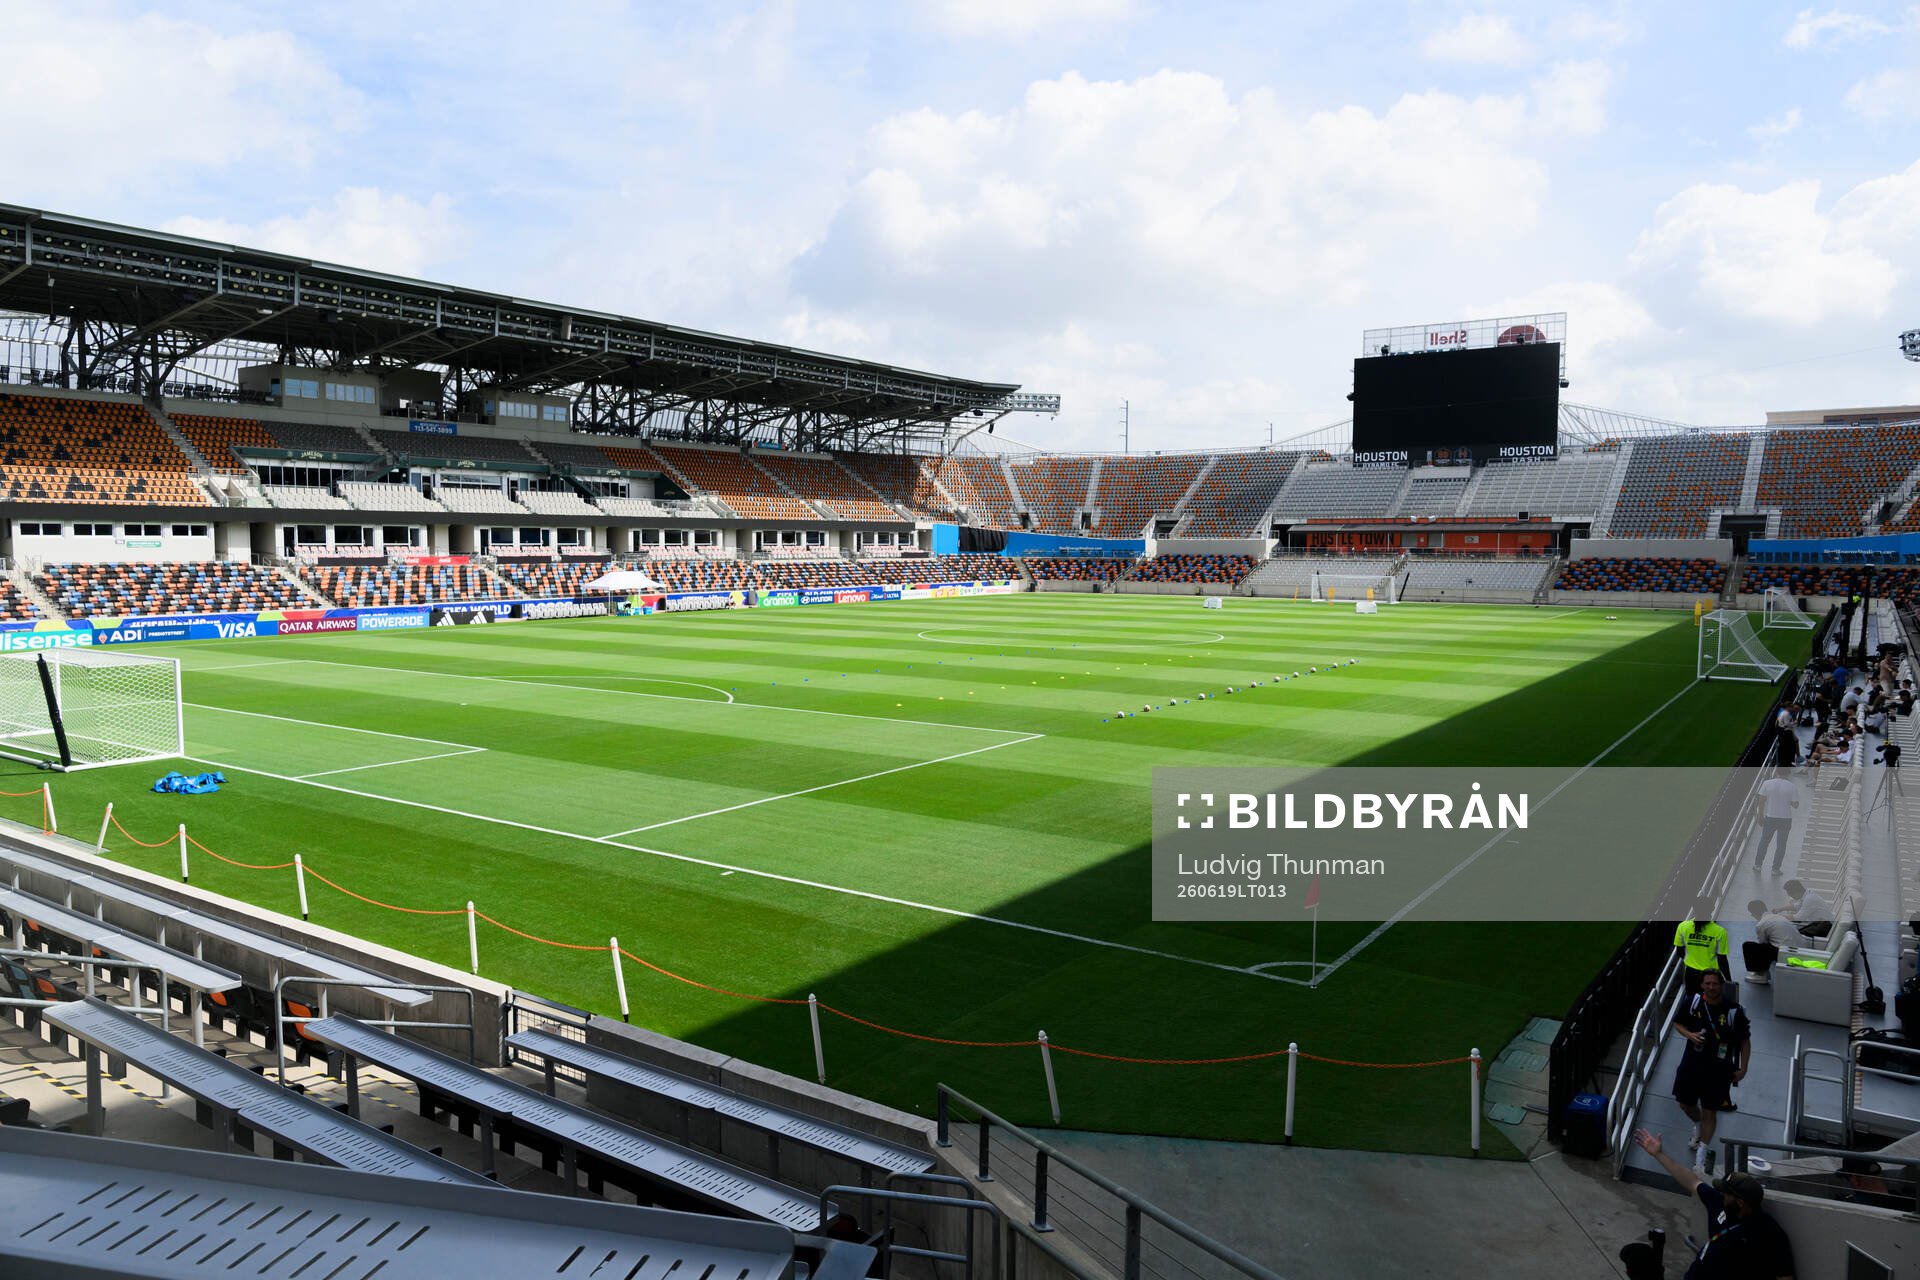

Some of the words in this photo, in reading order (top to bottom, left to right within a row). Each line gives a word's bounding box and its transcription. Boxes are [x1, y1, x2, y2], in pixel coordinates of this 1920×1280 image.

[1355, 450, 1408, 462] HOUSTON
[1499, 445, 1554, 457] HOUSTON
[1359, 532, 1394, 545] TOWN
[763, 597, 795, 606] aramco
[838, 592, 866, 603] Lenovo
[279, 621, 313, 633] QATAR
[316, 619, 356, 630] AIRWAYS
[361, 615, 424, 628] POWERADE
[110, 630, 142, 642] ADI
[215, 622, 257, 638] VISA
[1689, 933, 1715, 941] BEST
